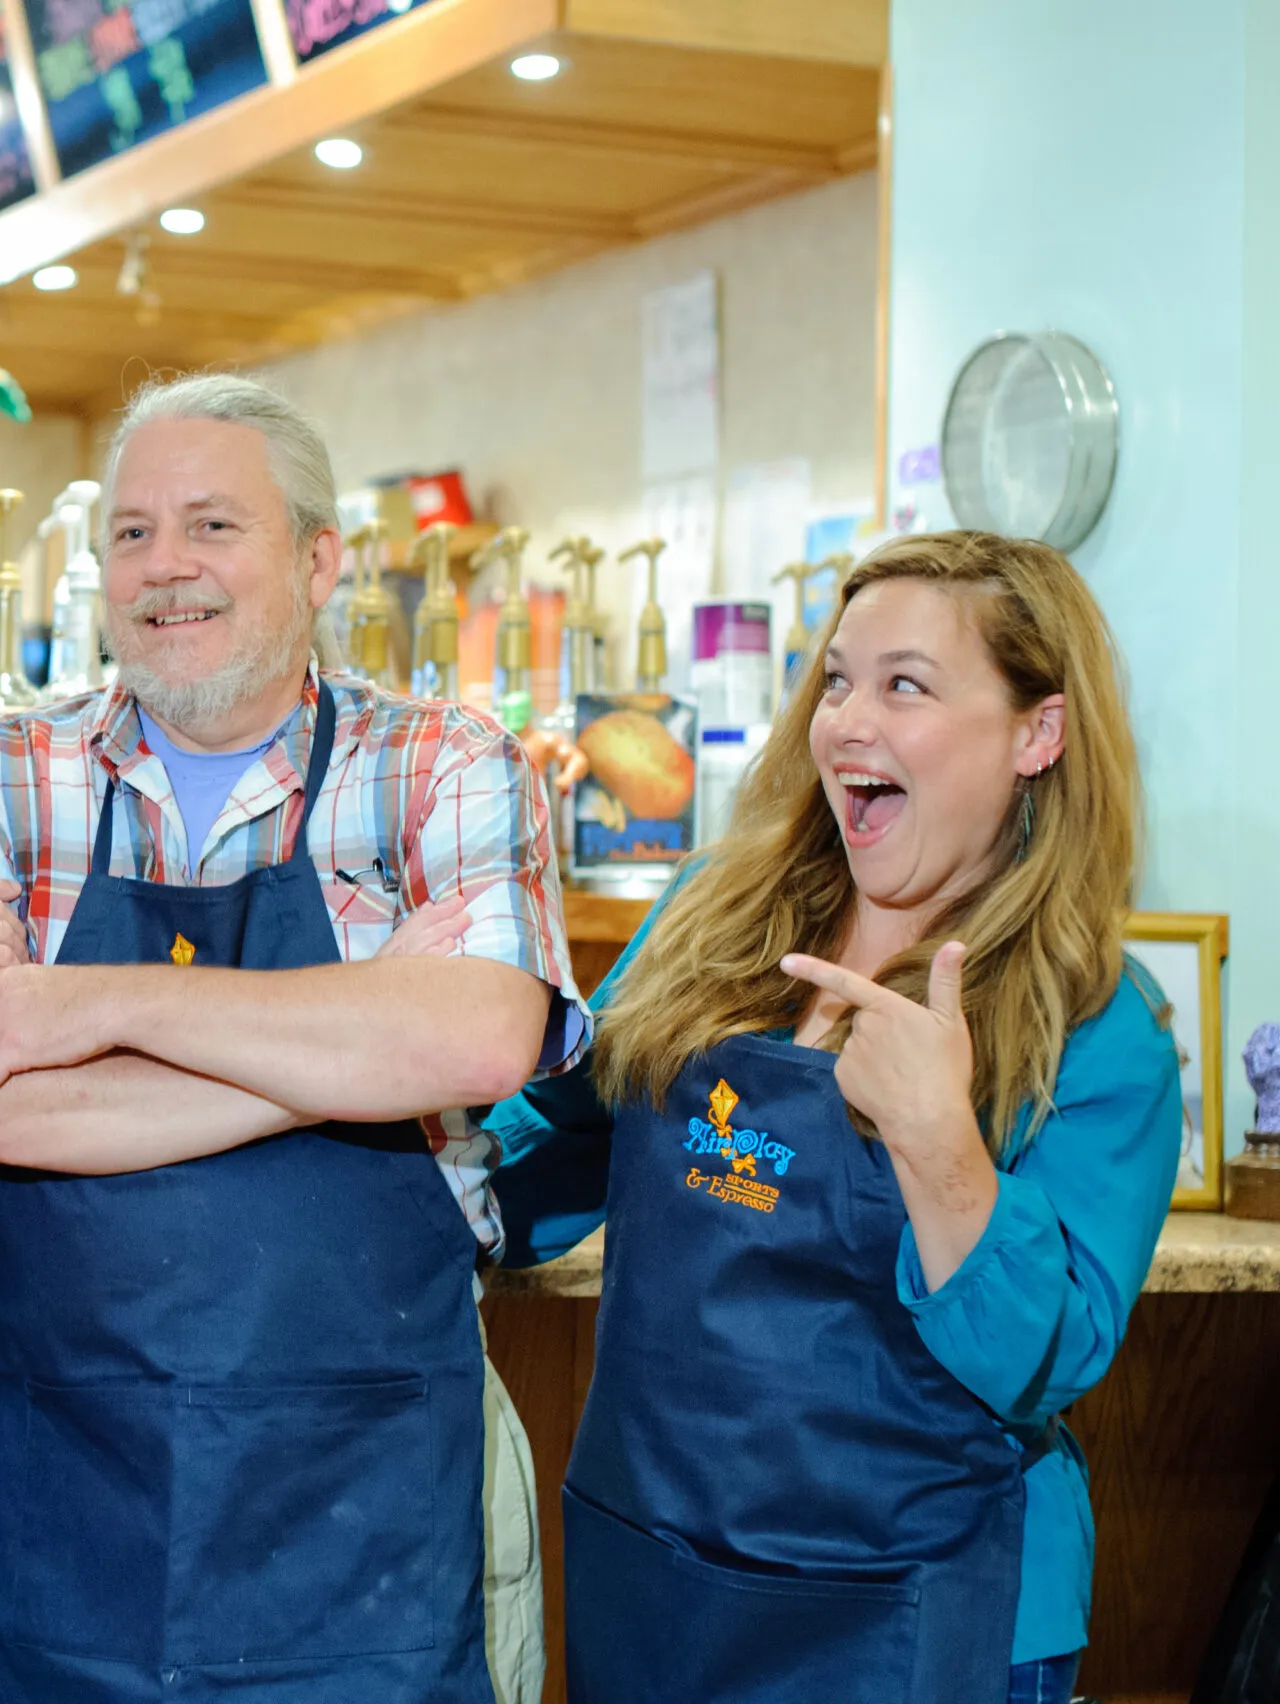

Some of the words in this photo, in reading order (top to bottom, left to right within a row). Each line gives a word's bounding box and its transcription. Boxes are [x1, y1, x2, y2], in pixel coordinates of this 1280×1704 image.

[686, 1167, 709, 1189] &
[707, 1176, 775, 1213] Espresso
[725, 1173, 780, 1199] SPORTS
